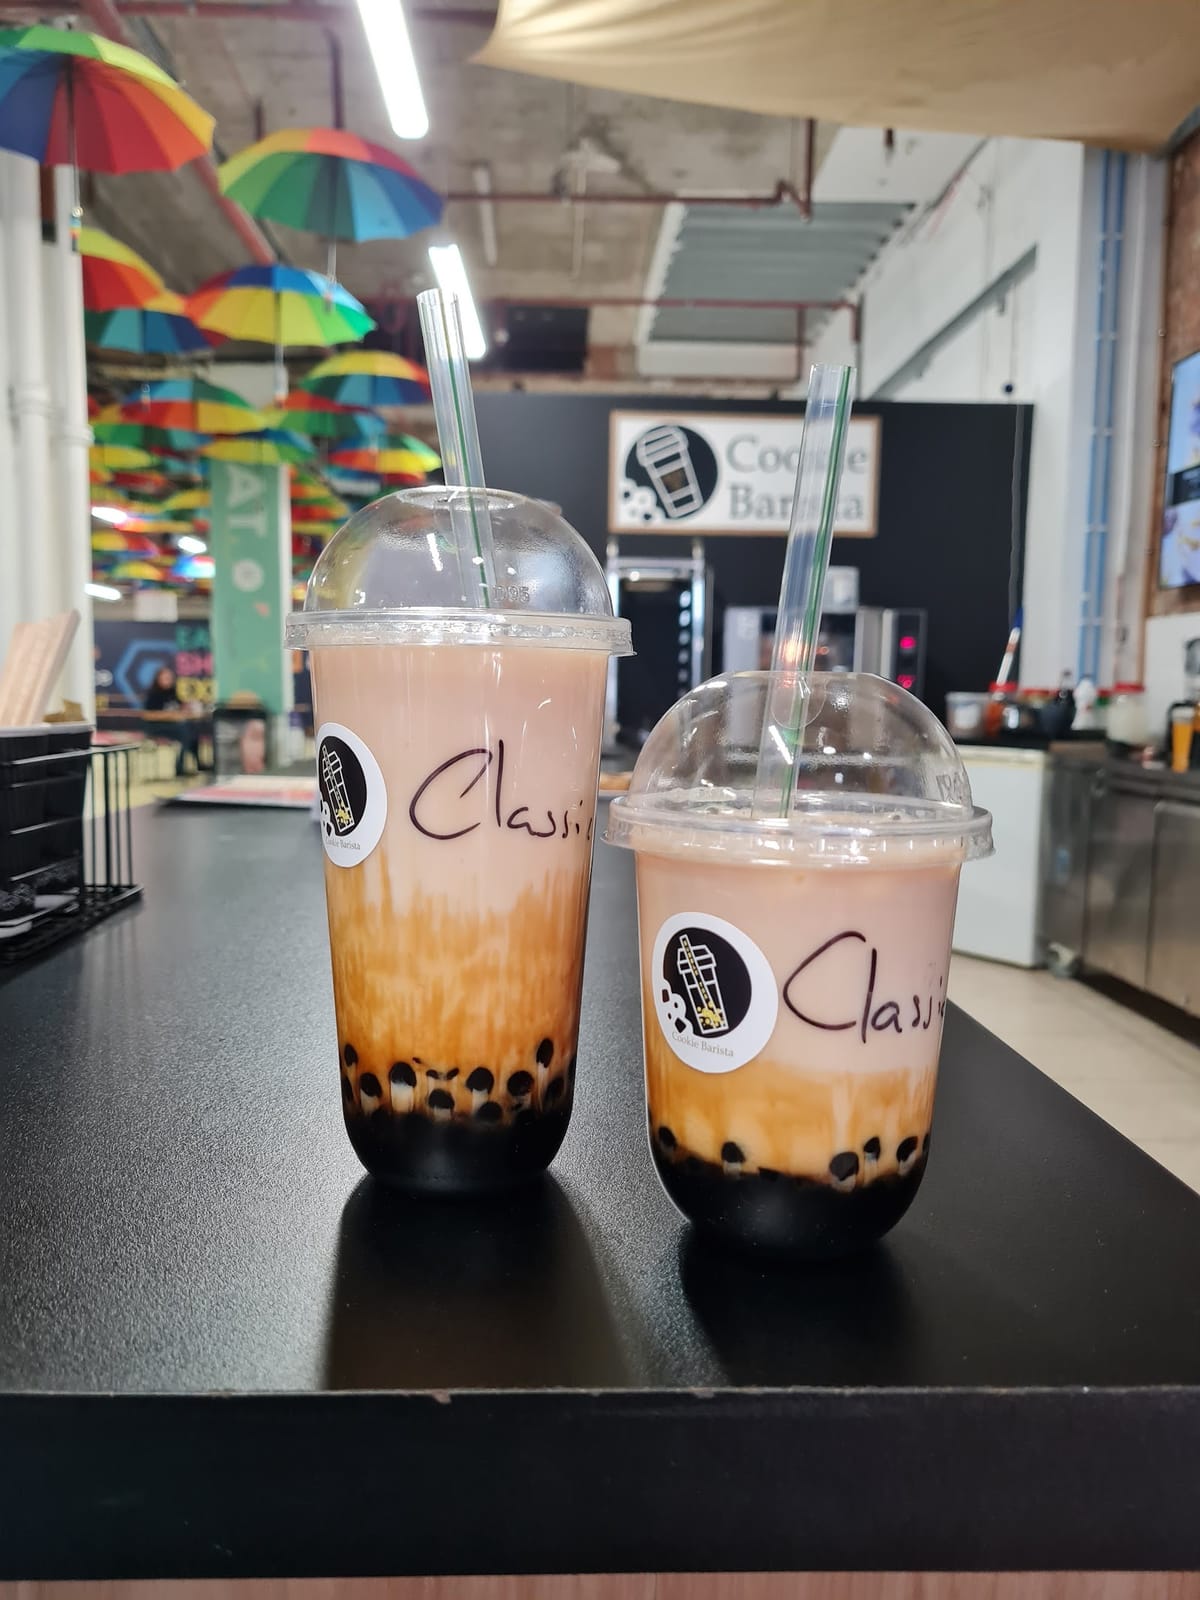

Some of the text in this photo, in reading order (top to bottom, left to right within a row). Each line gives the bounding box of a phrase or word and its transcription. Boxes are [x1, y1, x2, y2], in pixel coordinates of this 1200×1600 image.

[725, 433, 868, 474] Cooe
[727, 483, 865, 521] Bara
[671, 1030, 735, 1058] Cookie Barista
